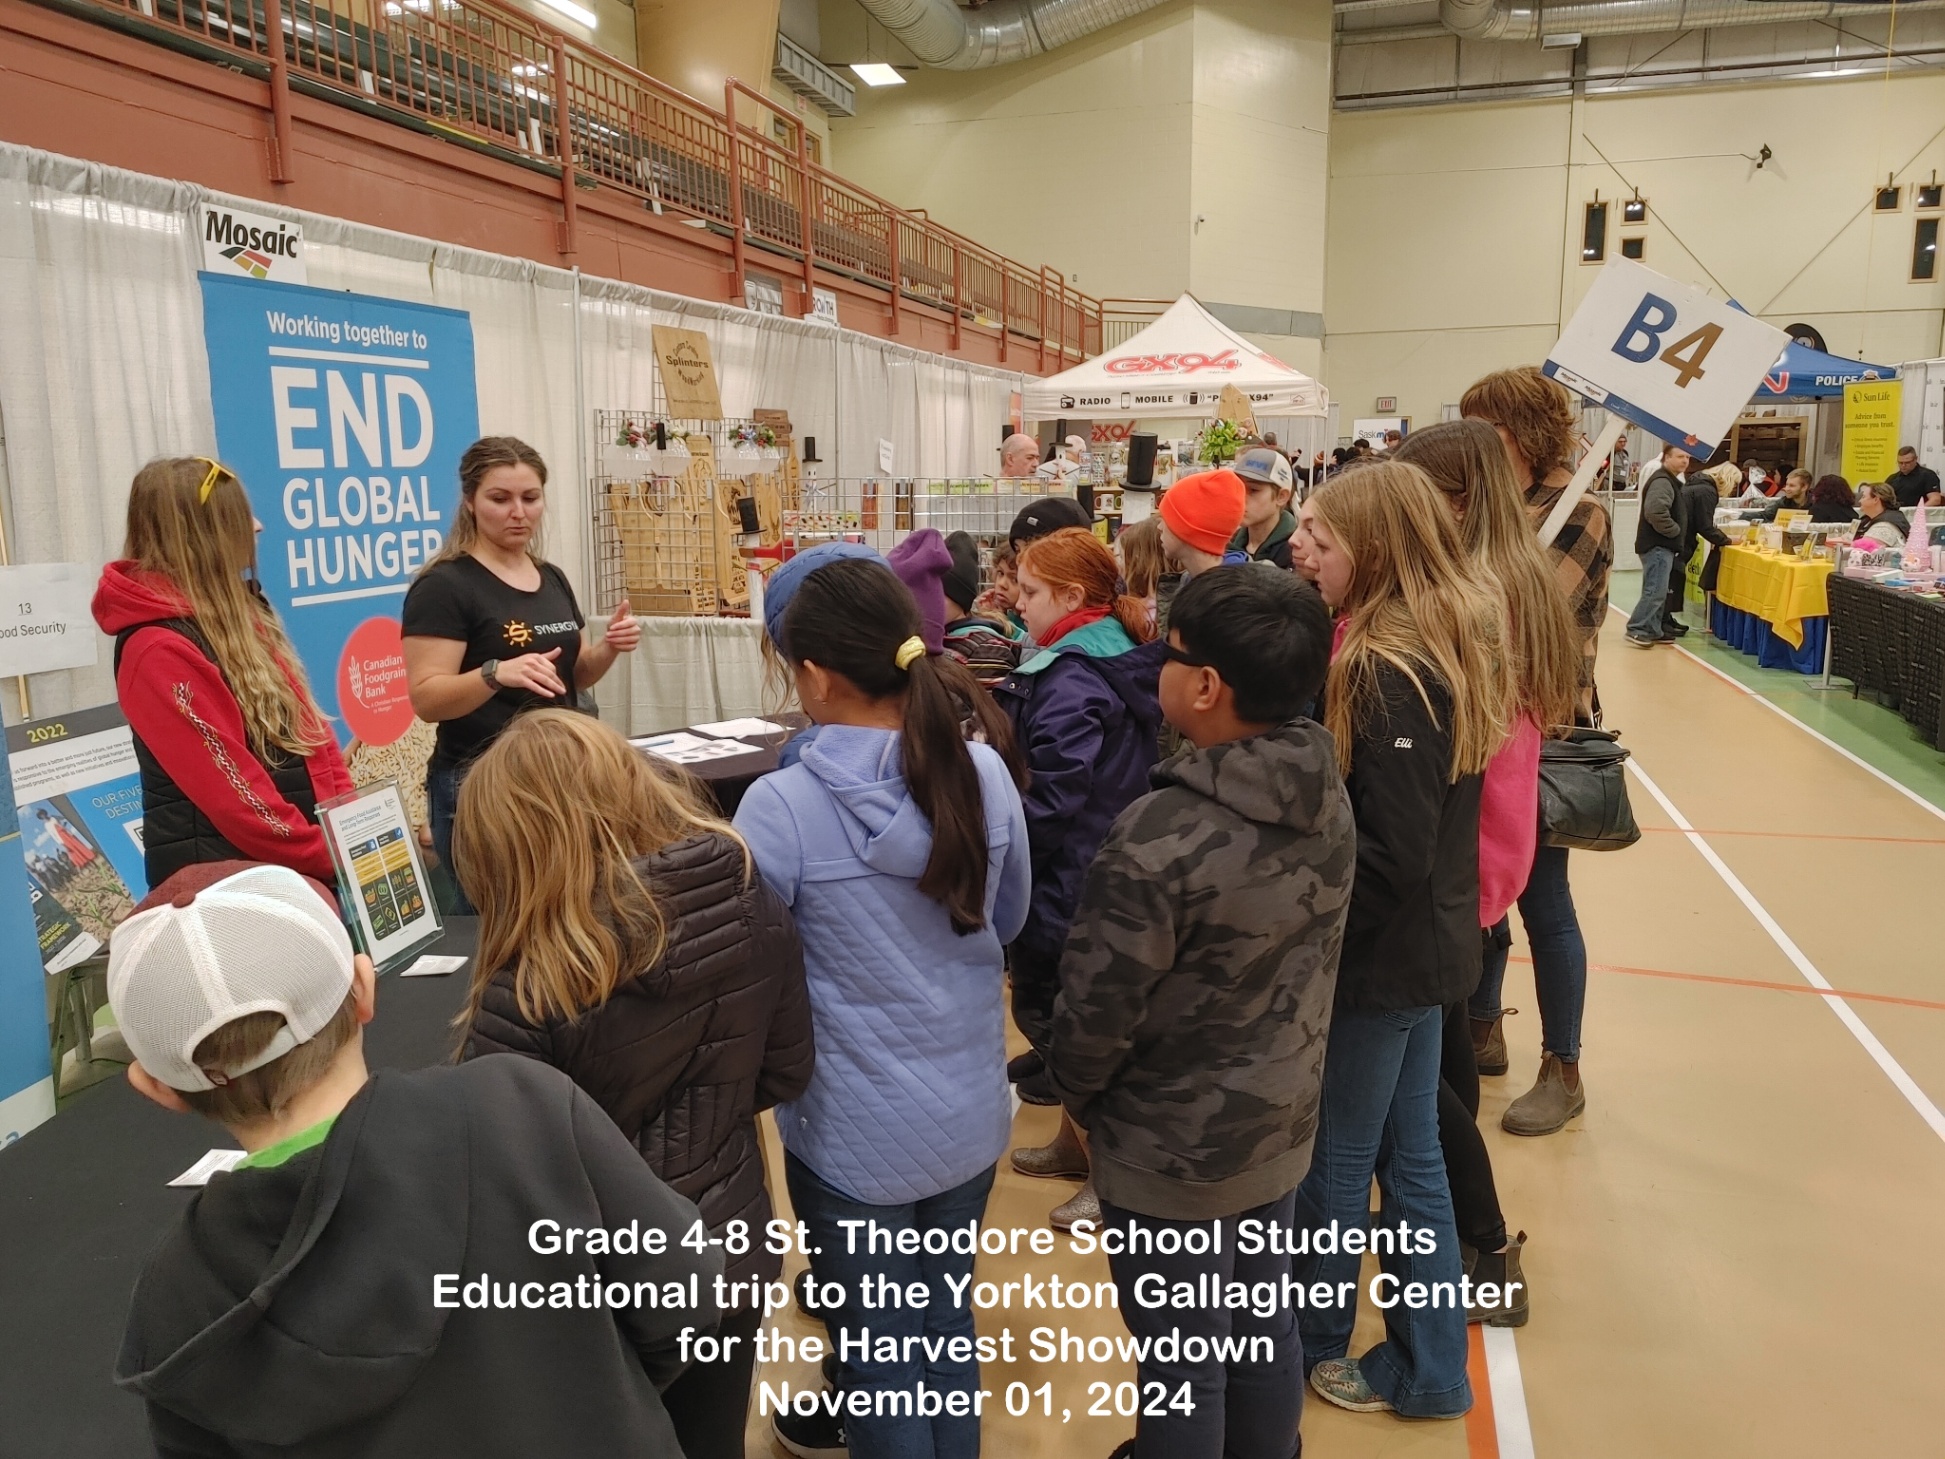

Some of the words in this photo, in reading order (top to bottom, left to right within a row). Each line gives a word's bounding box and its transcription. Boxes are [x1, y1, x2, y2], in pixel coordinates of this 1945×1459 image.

[206, 211, 298, 258] Mosaic
[266, 311, 340, 343] Working
[344, 321, 409, 347] together
[412, 330, 427, 349] to
[1611, 292, 1724, 388] B4
[666, 355, 709, 369] Splinters
[1103, 349, 1242, 374] GX94
[1815, 375, 1858, 386] POLICE
[1080, 397, 1111, 406] RADIO
[1135, 395, 1174, 404] MOBILE
[1381, 400, 1392, 408] EXIT
[1863, 393, 1877, 402] Sun
[1877, 391, 1890, 401] Life
[271, 366, 434, 468] END
[1855, 412, 1872, 420] Advice
[1873, 412, 1887, 420] from
[1869, 422, 1879, 430] you
[283, 475, 440, 530] GLOBAL
[18, 602, 32, 614] 13
[0, 625, 17, 638] ood
[20, 621, 66, 636] Security
[363, 655, 402, 671] Canadian
[365, 667, 407, 685] Foodgrain
[365, 683, 386, 698] Bank
[27, 723, 68, 743] 2022
[92, 793, 118, 808] OUR
[118, 784, 143, 800] FIVE
